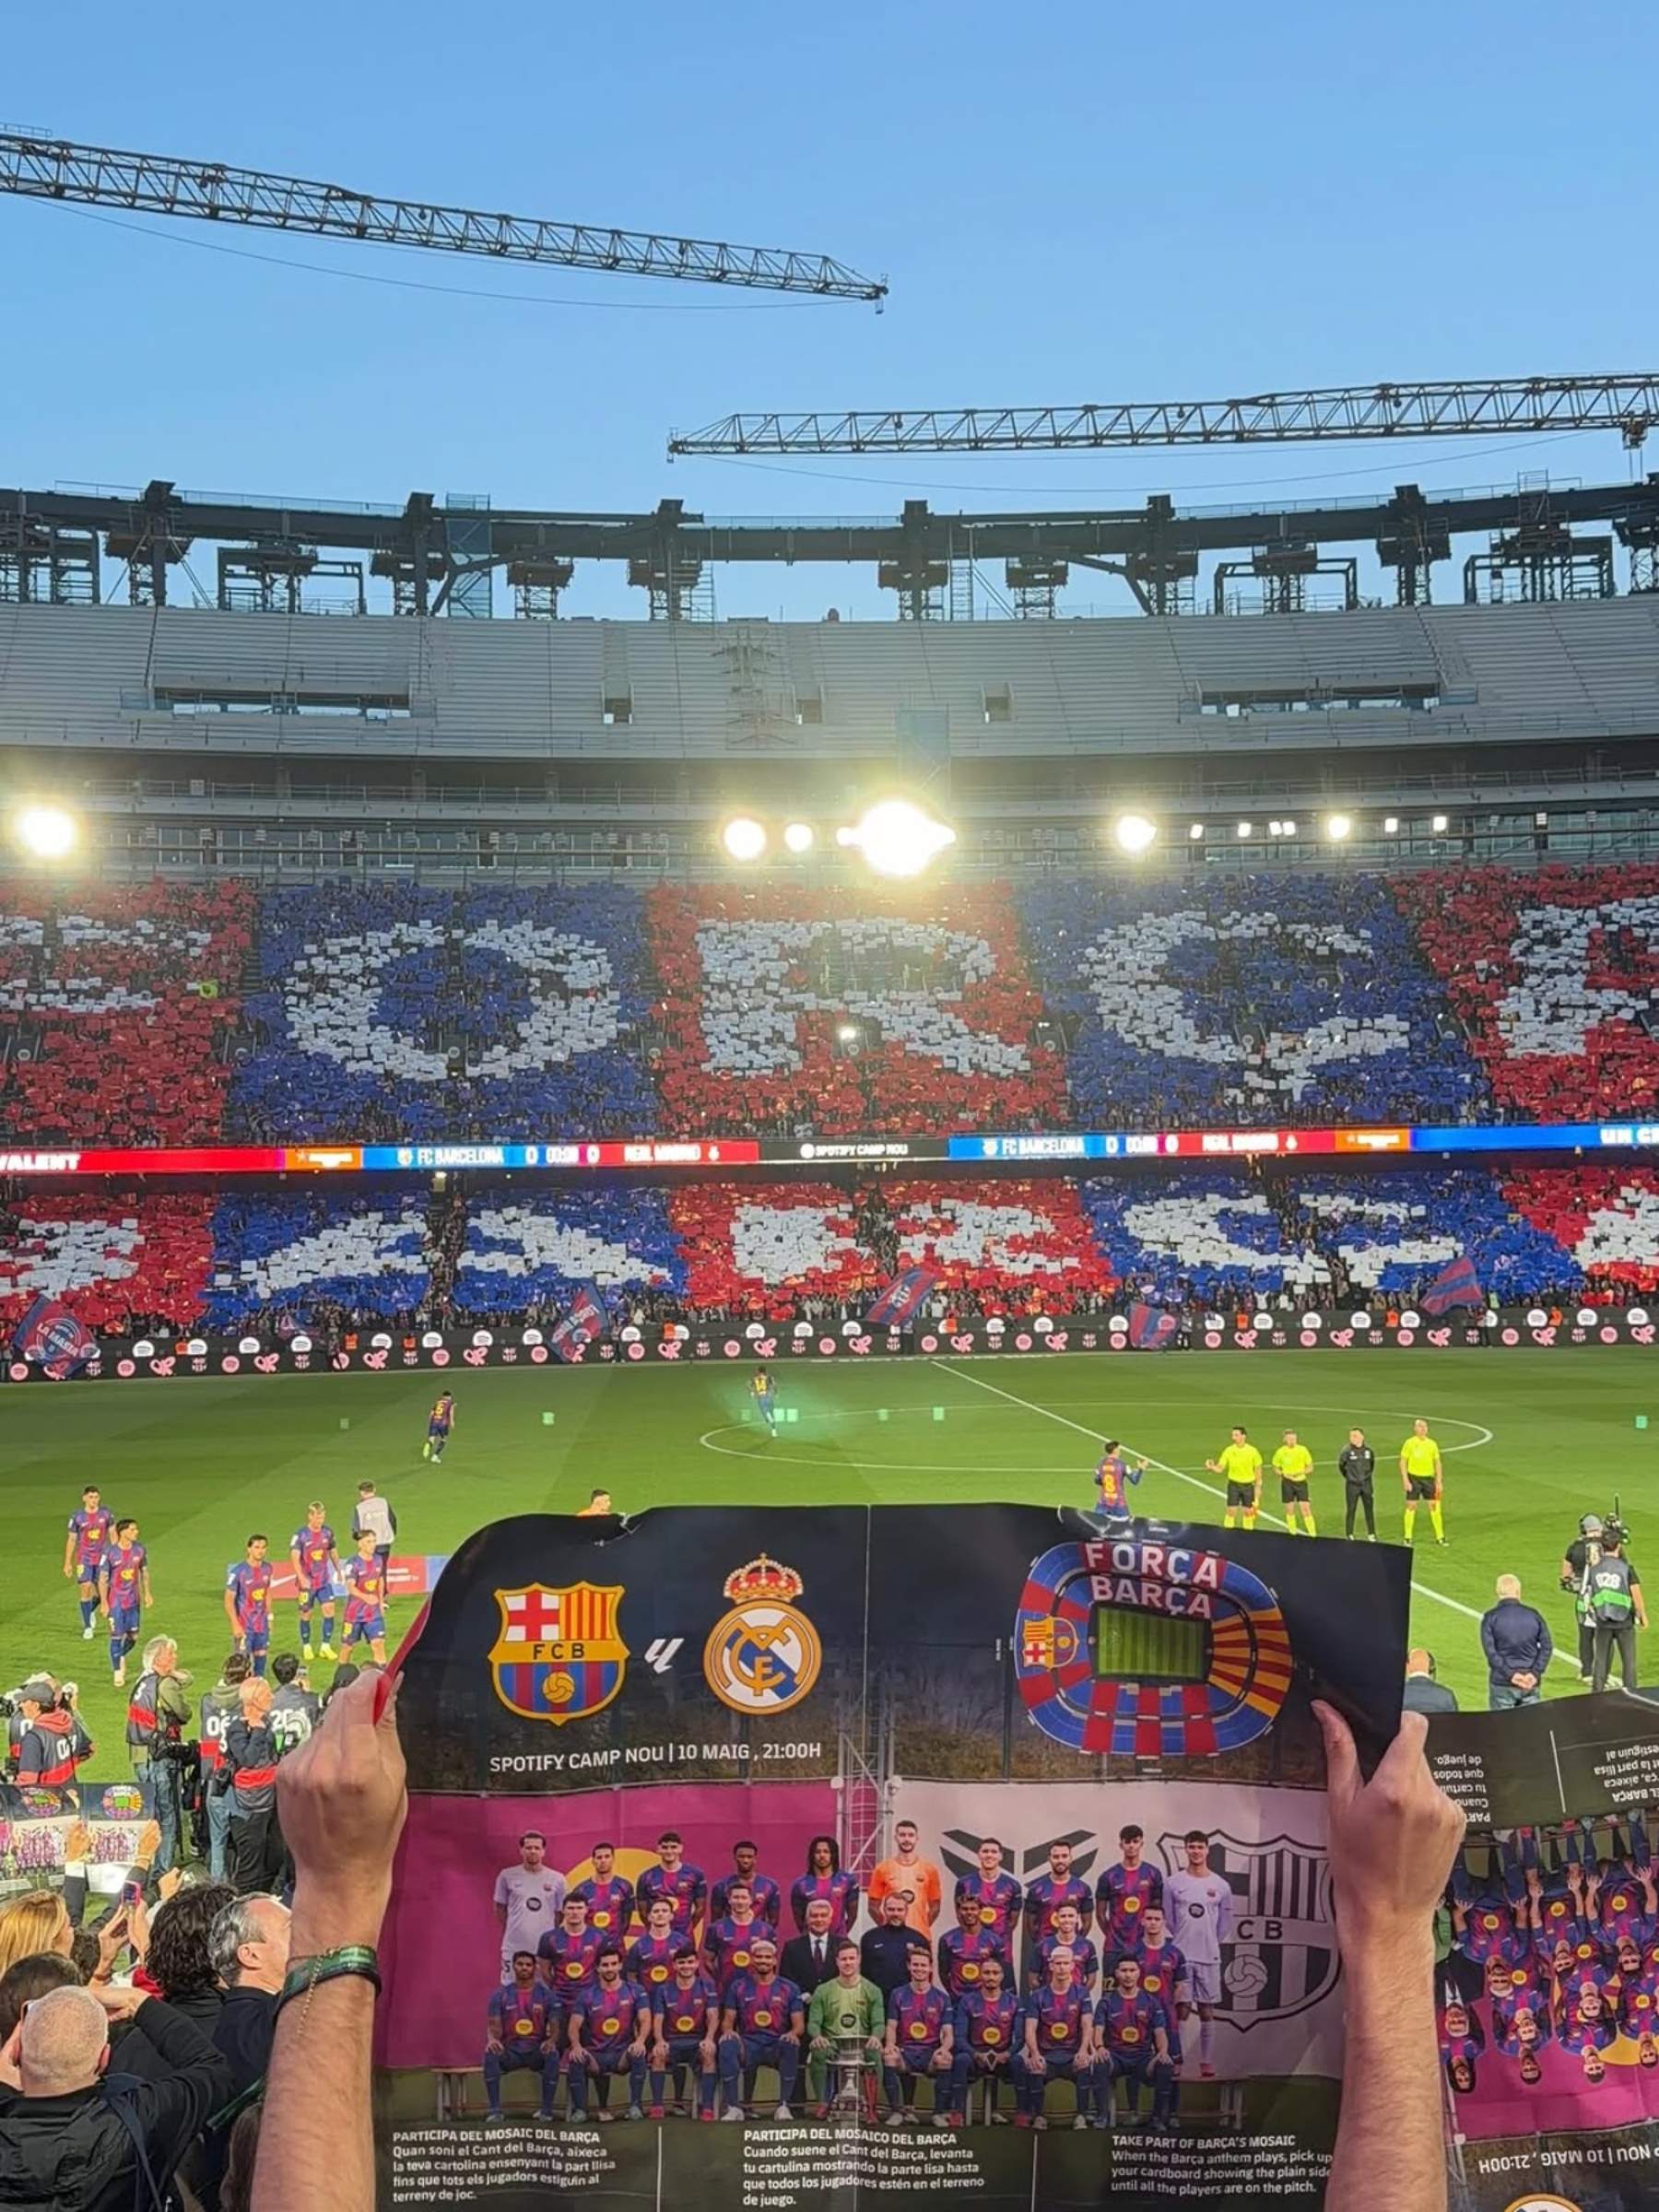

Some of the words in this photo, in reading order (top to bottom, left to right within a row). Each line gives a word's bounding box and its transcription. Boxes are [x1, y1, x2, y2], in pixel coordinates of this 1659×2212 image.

[1085, 1543, 1217, 1589] FORÇA
[1091, 1575, 1210, 1618] BARÇA
[489, 1755, 565, 1771] SPOTIFY
[569, 1750, 620, 1768] CAMP
[626, 1747, 664, 1763] NOU
[678, 1745, 695, 1759] 10
[702, 1745, 749, 1759] MAIG
[763, 1743, 820, 1758] 21:00H
[1468, 1756, 1482, 1766] de
[1433, 1771, 1463, 1781] todos
[1465, 1769, 1484, 1778] que
[1612, 1788, 1648, 1803] BARÇA
[1237, 1920, 1283, 1940] CB
[394, 2130, 457, 2143] PARTICIPA
[461, 2130, 483, 2141] DEL
[486, 2129, 533, 2141] MOSAIC
[535, 2130, 558, 2140] DEL
[559, 2130, 599, 2144] BARÇA
[745, 2129, 807, 2141] PARTICIPA
[810, 2128, 831, 2139] DEL
[835, 2129, 889, 2144] MOSAICO
[892, 2134, 914, 2145] DEL
[917, 2134, 957, 2147] BARÇA
[1112, 2136, 1143, 2147] TAKE
[1146, 2136, 1177, 2148] PART
[1180, 2138, 1194, 2148] OF
[1249, 2136, 1295, 2147] MOSAIC
[394, 2147, 425, 2158] Quan
[429, 2144, 454, 2156] soni
[458, 2145, 469, 2157] el
[473, 2144, 500, 2156] Cant
[504, 2143, 524, 2154] del
[526, 2143, 564, 2157] Barça,
[567, 2147, 606, 2158] aixeca
[745, 2145, 788, 2158] Cuando
[792, 2146, 826, 2156] suene
[830, 2144, 840, 2155] el
[842, 2144, 867, 2157] Cant
[871, 2147, 888, 2159] del
[892, 2148, 927, 2162] Barça,
[930, 2147, 972, 2159] levanta
[1112, 2150, 1147, 2161] When
[1149, 2152, 1168, 2163] the
[1171, 2153, 1205, 2166] Barça
[1207, 2152, 1251, 2162] anthem
[1253, 2151, 1287, 2163] plays,
[1290, 2150, 1314, 2162] pick
[1317, 2154, 1333, 2163] up
[1541, 2150, 1583, 2166] MAIG
[1587, 2149, 1604, 2162] 10
[1617, 2144, 1651, 2161] NOU
[394, 2161, 404, 2171] la
[434, 2159, 486, 2171] cartolina
[488, 2158, 550, 2171] ensenyant
[552, 2159, 562, 2170] la
[565, 2161, 589, 2173] part
[592, 2159, 616, 2170] llisa
[744, 2162, 755, 2173] tu
[759, 2161, 810, 2173] cartulina
[813, 2160, 875, 2173] mostrando
[877, 2162, 888, 2174] la
[891, 2164, 922, 2176] parte
[924, 2162, 944, 2174] lisa
[947, 2161, 979, 2173] hasta
[1478, 2155, 1531, 2174] 21:00H
[394, 2175, 415, 2186] fins
[418, 2176, 439, 2187] que
[442, 2174, 465, 2185] tots
[467, 2173, 484, 2185] els
[486, 2172, 537, 2186] jugadors
[540, 2174, 586, 2188] estiguin
[589, 2174, 599, 2184] al
[1112, 2167, 1137, 2177] your
[1141, 2167, 1200, 2179] cardboard
[1205, 2167, 1253, 2180] showing
[1256, 2167, 1275, 2177] the
[1277, 2167, 1305, 2179] plain
[744, 2179, 765, 2191] que
[769, 2177, 800, 2189] todos
[803, 2176, 818, 2187] los
[821, 2176, 877, 2189] jugadores
[879, 2177, 911, 2189] estén
[913, 2179, 927, 2189] en
[930, 2177, 941, 2188] el
[943, 2177, 984, 2188] terreno
[1111, 2181, 1137, 2191] until
[1140, 2181, 1154, 2191] all
[1158, 2182, 1176, 2194] the
[1180, 2183, 1221, 2197] players
[1225, 2184, 1242, 2194] are
[1246, 2184, 1260, 2194] on
[1264, 2182, 1282, 2194] the
[1285, 2181, 1316, 2194] pitch.
[394, 2192, 435, 2203] terreny
[439, 2190, 453, 2201] de
[455, 2188, 477, 2201] joc.
[744, 2194, 758, 2206] de
[760, 2194, 796, 2207] juego.
